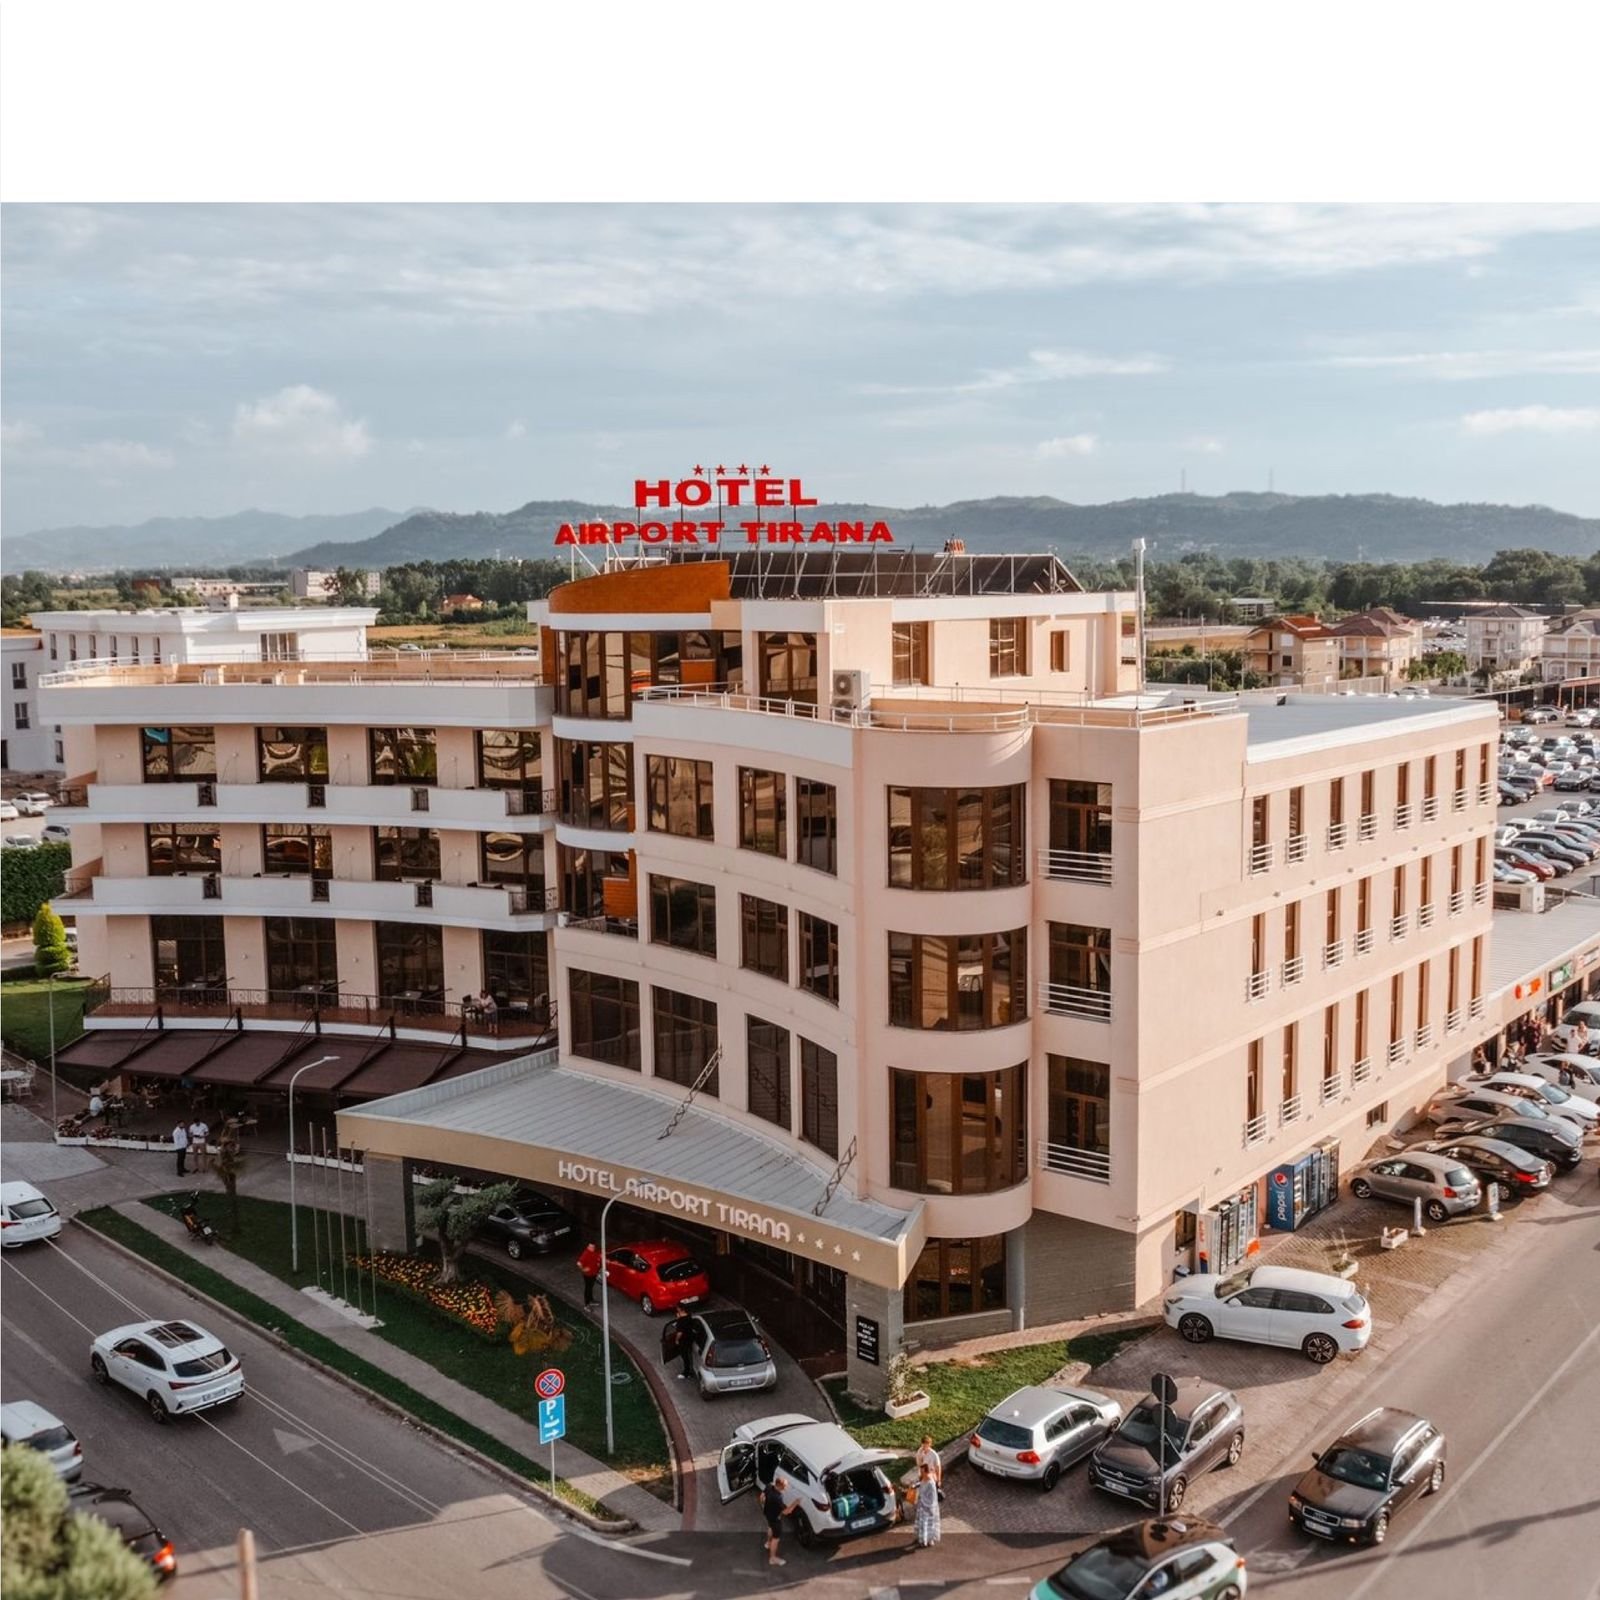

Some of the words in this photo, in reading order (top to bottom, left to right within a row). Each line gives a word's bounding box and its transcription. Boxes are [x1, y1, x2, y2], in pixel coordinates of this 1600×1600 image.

[635, 479, 818, 507] HOTEL
[554, 521, 725, 545] AIRPORT
[740, 521, 894, 543] TIRANA
[558, 1160, 621, 1193] HOTEL
[625, 1177, 712, 1217] AIRPORT
[716, 1203, 791, 1243] TIRANA
[1276, 1190, 1287, 1222] pepsi
[546, 1400, 556, 1415] P
